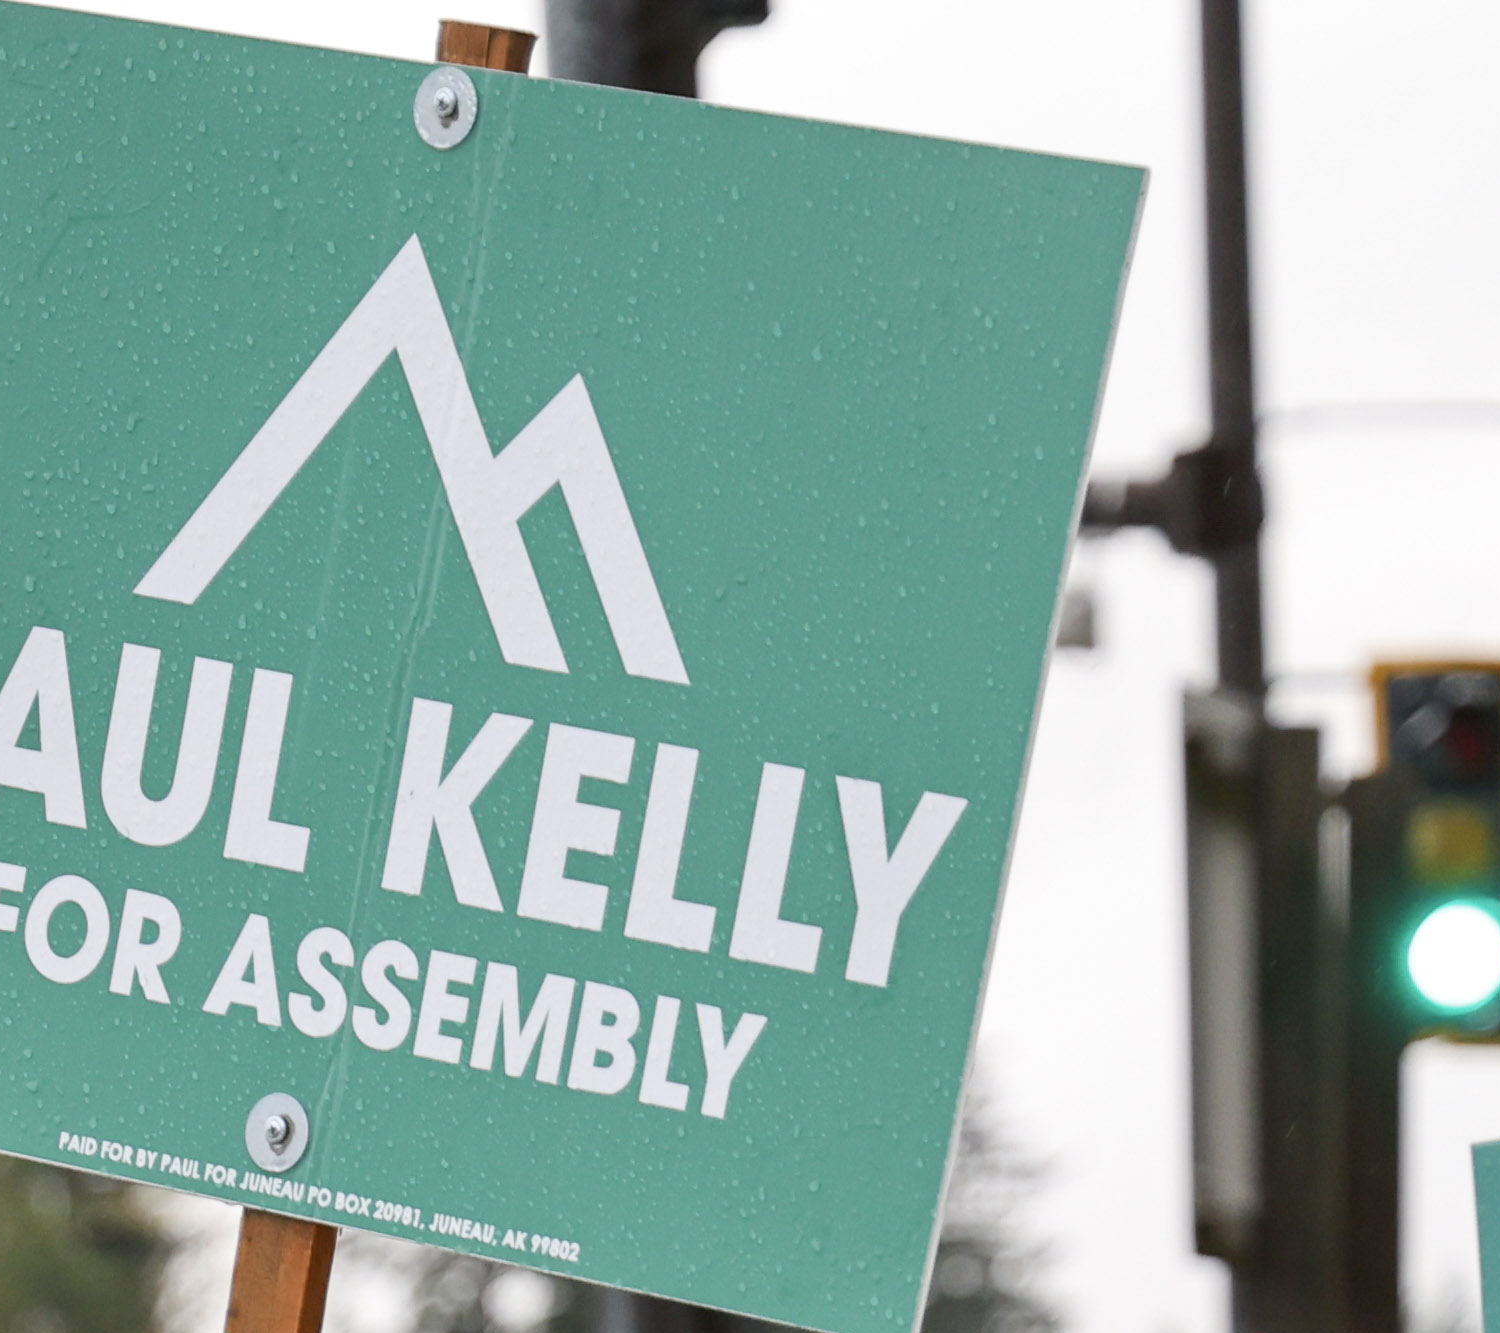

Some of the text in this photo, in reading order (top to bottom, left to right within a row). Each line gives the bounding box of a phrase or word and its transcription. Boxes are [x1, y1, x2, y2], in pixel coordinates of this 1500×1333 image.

[382, 698, 968, 987] KELLY
[202, 914, 767, 1119] ASSEMBLY
[58, 1131, 581, 1263] PAID FOR BY PAUL FOR JUNEAU PO BOX 20981, JUNEAU, AK 99802
